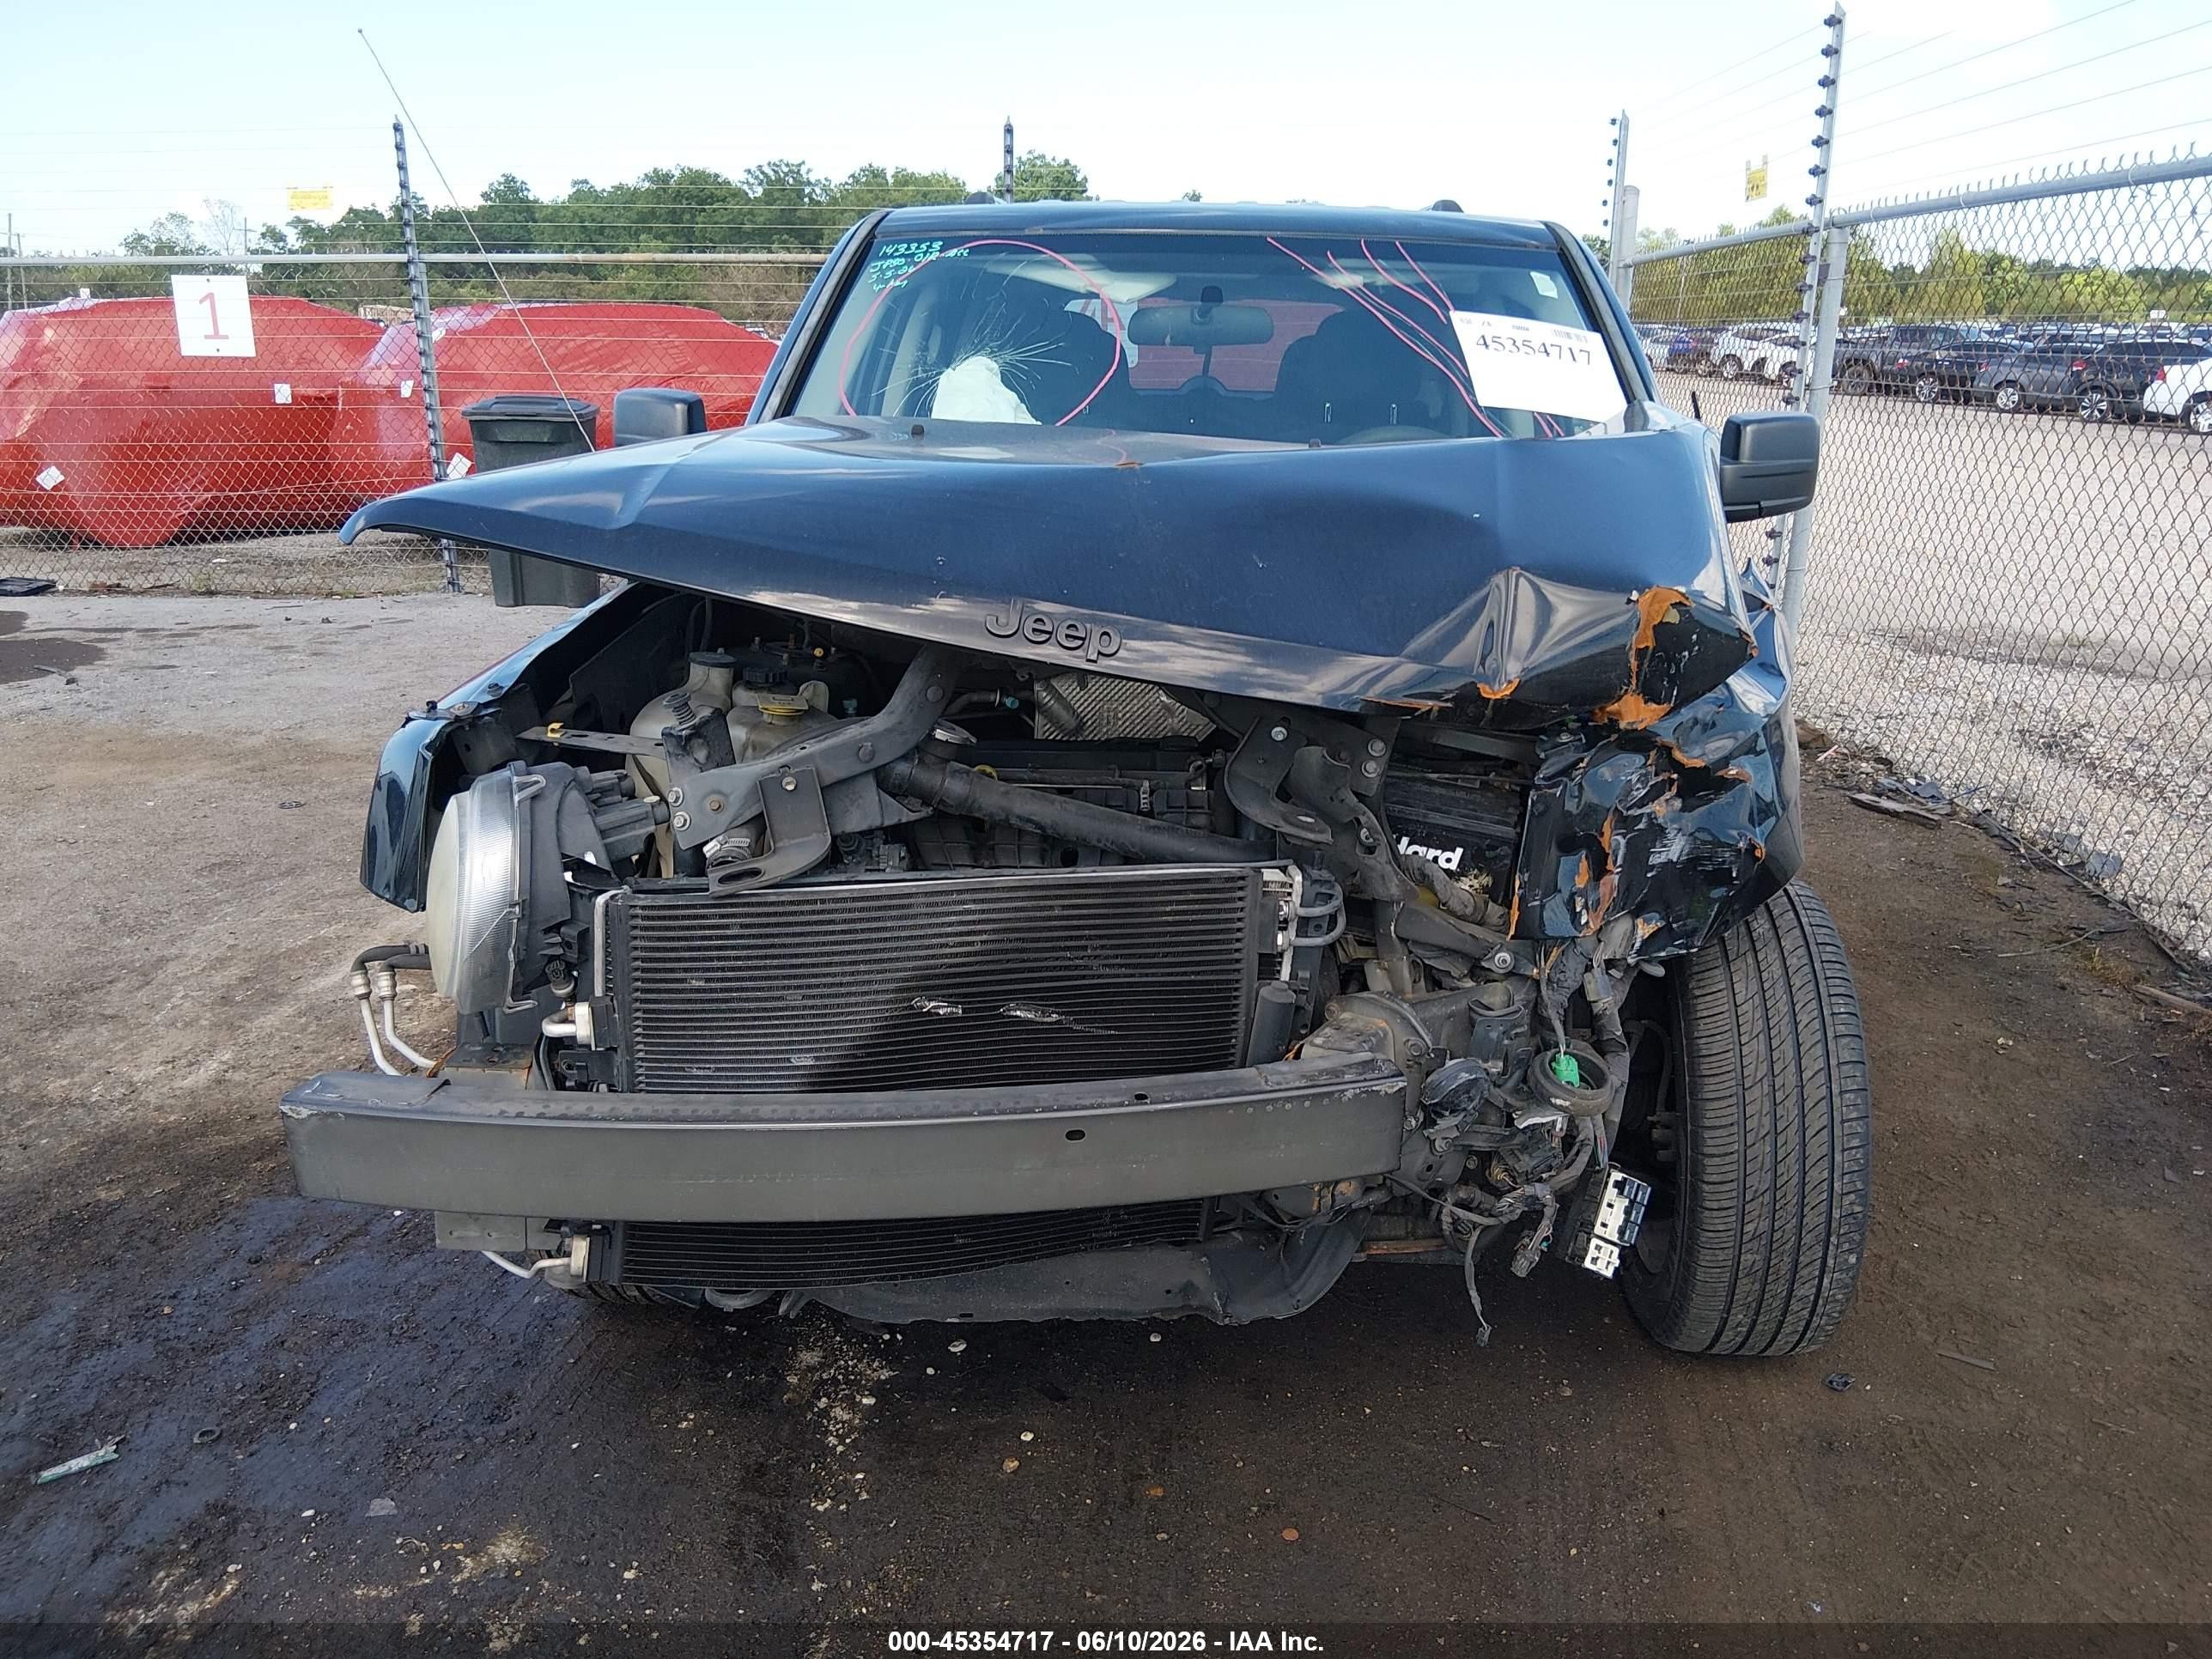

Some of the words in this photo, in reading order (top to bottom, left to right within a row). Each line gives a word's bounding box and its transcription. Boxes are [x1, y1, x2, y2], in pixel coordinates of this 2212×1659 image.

[198, 292, 229, 340] 1
[1475, 333, 1591, 366] 45354717
[985, 598, 1122, 664] Jeep
